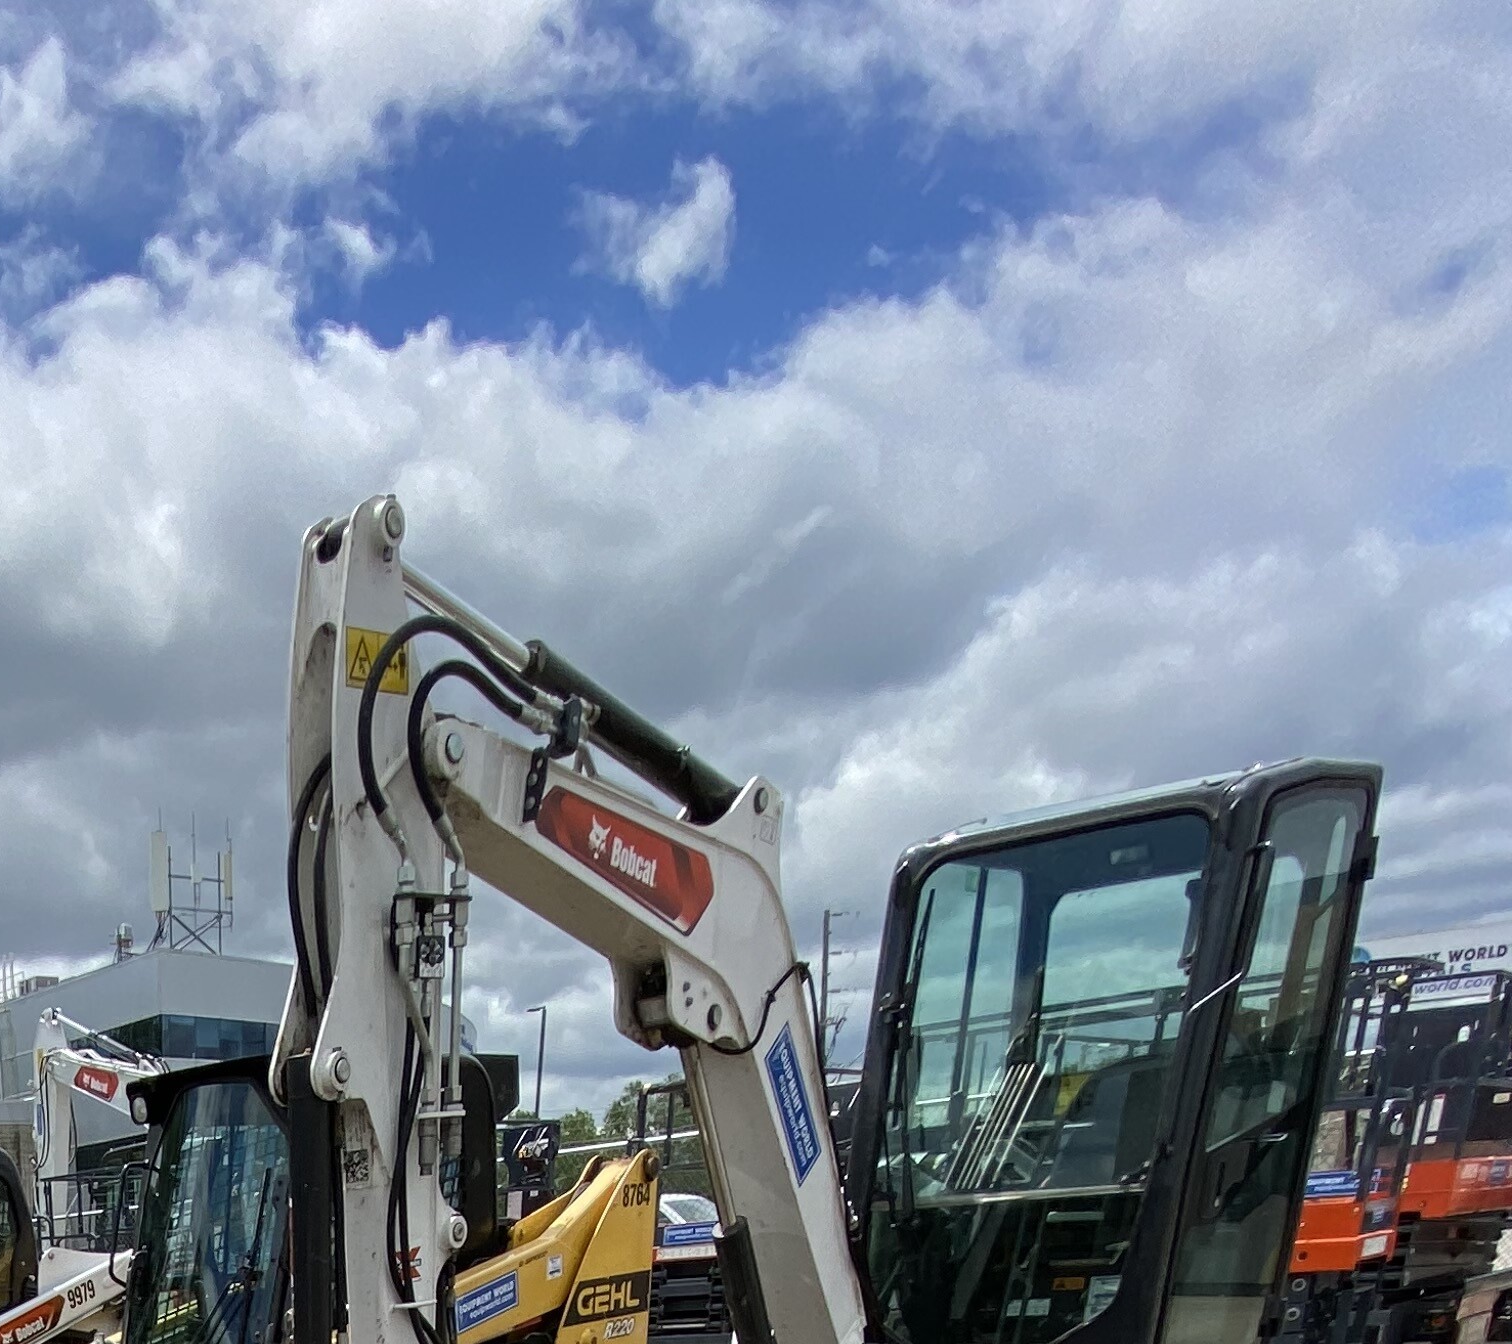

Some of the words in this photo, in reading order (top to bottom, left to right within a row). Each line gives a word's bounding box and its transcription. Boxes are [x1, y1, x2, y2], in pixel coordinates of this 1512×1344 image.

[609, 836, 657, 888] Bobcat
[1448, 945, 1508, 963] WORLD
[779, 1041, 803, 1115] EQUIPMENT
[797, 1112, 814, 1160] WORLD
[778, 1074, 807, 1167] equipworld.com
[622, 1183, 650, 1207] 8764
[67, 1279, 96, 1309] 9979
[577, 1281, 640, 1317] GEHL
[15, 1315, 45, 1342] Bobcat
[603, 1318, 636, 1341] R220
